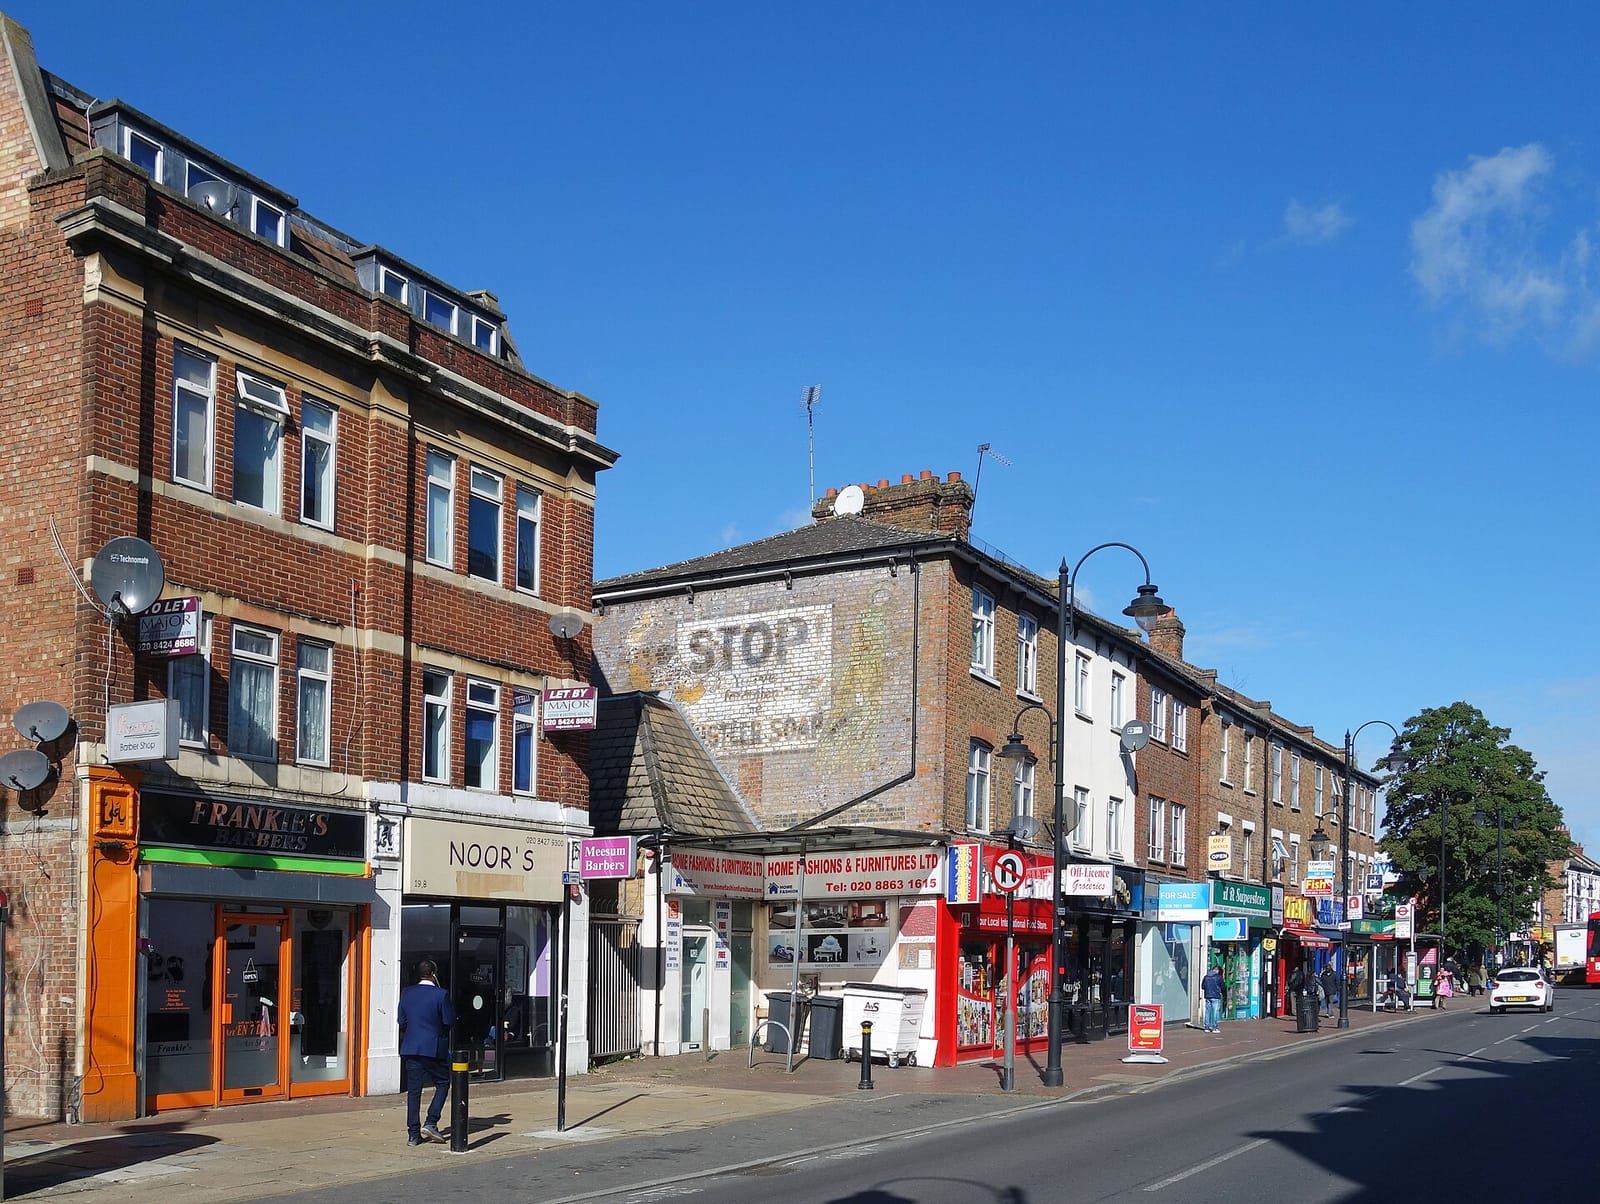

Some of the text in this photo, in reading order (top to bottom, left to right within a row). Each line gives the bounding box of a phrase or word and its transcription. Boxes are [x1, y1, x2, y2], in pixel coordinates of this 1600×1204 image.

[120, 554, 149, 564] Technomate
[164, 599, 191, 612] LET
[141, 614, 191, 631] MAJOR
[153, 640, 172, 650] 8424
[689, 616, 809, 675] STOP
[549, 689, 588, 699] LET BY
[548, 700, 590, 711] MAJOR
[120, 741, 155, 752] Barber Shop
[189, 800, 329, 836] FRANKIE'S
[214, 829, 308, 851] BARBERS
[526, 836, 536, 845] 020
[537, 837, 550, 846] 8427
[449, 841, 534, 871] NOOR'S
[585, 846, 626, 857] Meesum
[585, 859, 625, 871] Barbers
[672, 853, 762, 876] HOME FASHIONS & FURNITURES LTD
[768, 861, 793, 877] HOME
[845, 857, 852, 873] &
[855, 854, 917, 873] FURNITURES
[919, 853, 938, 869] LTD
[1070, 867, 1110, 878] Off-Licence
[825, 878, 936, 893] Tel: 020 8863 1615
[1072, 879, 1106, 893] Groceries
[1306, 879, 1326, 889] Fish
[1160, 891, 1197, 899] FOR SALE
[1229, 887, 1235, 901] R
[1235, 887, 1266, 906] Superstore
[987, 917, 999, 927] Local
[1000, 917, 1026, 929] Inteational
[249, 1024, 255, 1036] 7
